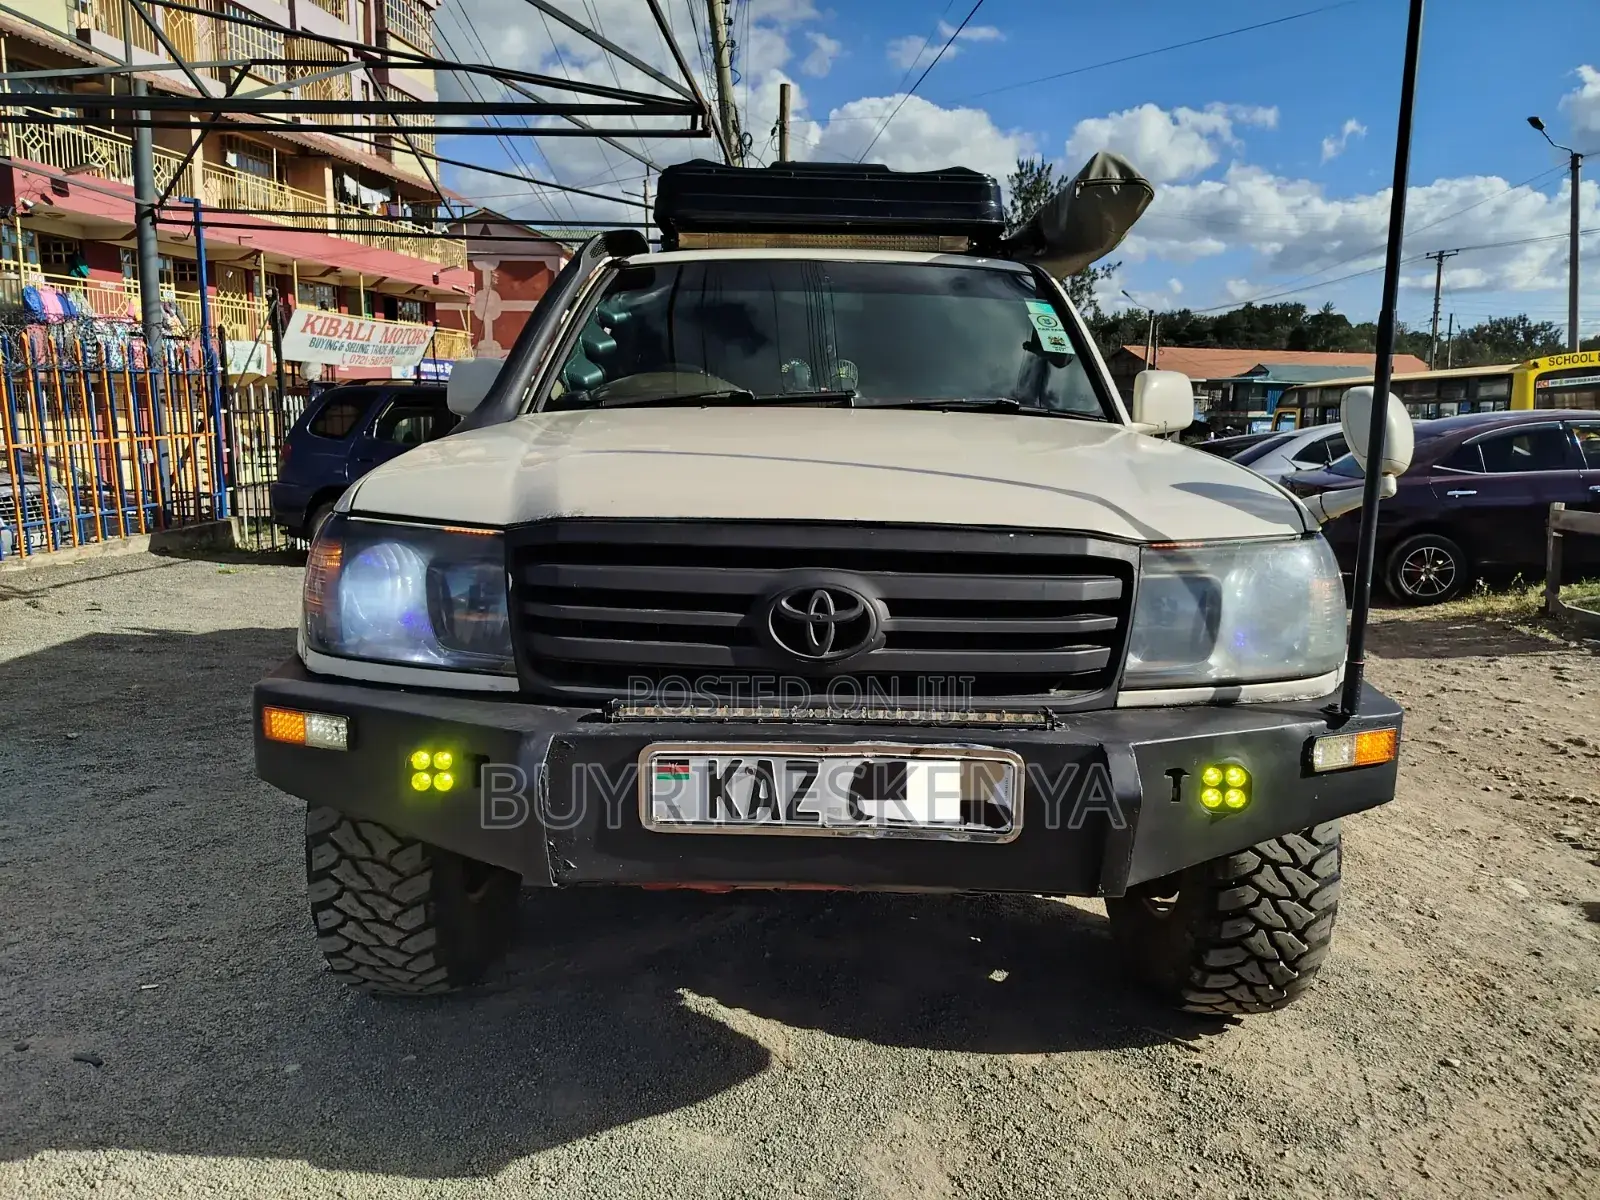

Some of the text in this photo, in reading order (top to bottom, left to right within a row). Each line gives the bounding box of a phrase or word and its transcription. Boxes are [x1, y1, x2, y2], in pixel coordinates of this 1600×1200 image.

[300, 313, 430, 345] KIBALI MOTORS
[309, 337, 339, 351] BUYING
[1548, 353, 1595, 367] SCHOOL
[707, 758, 821, 822] KAZ
